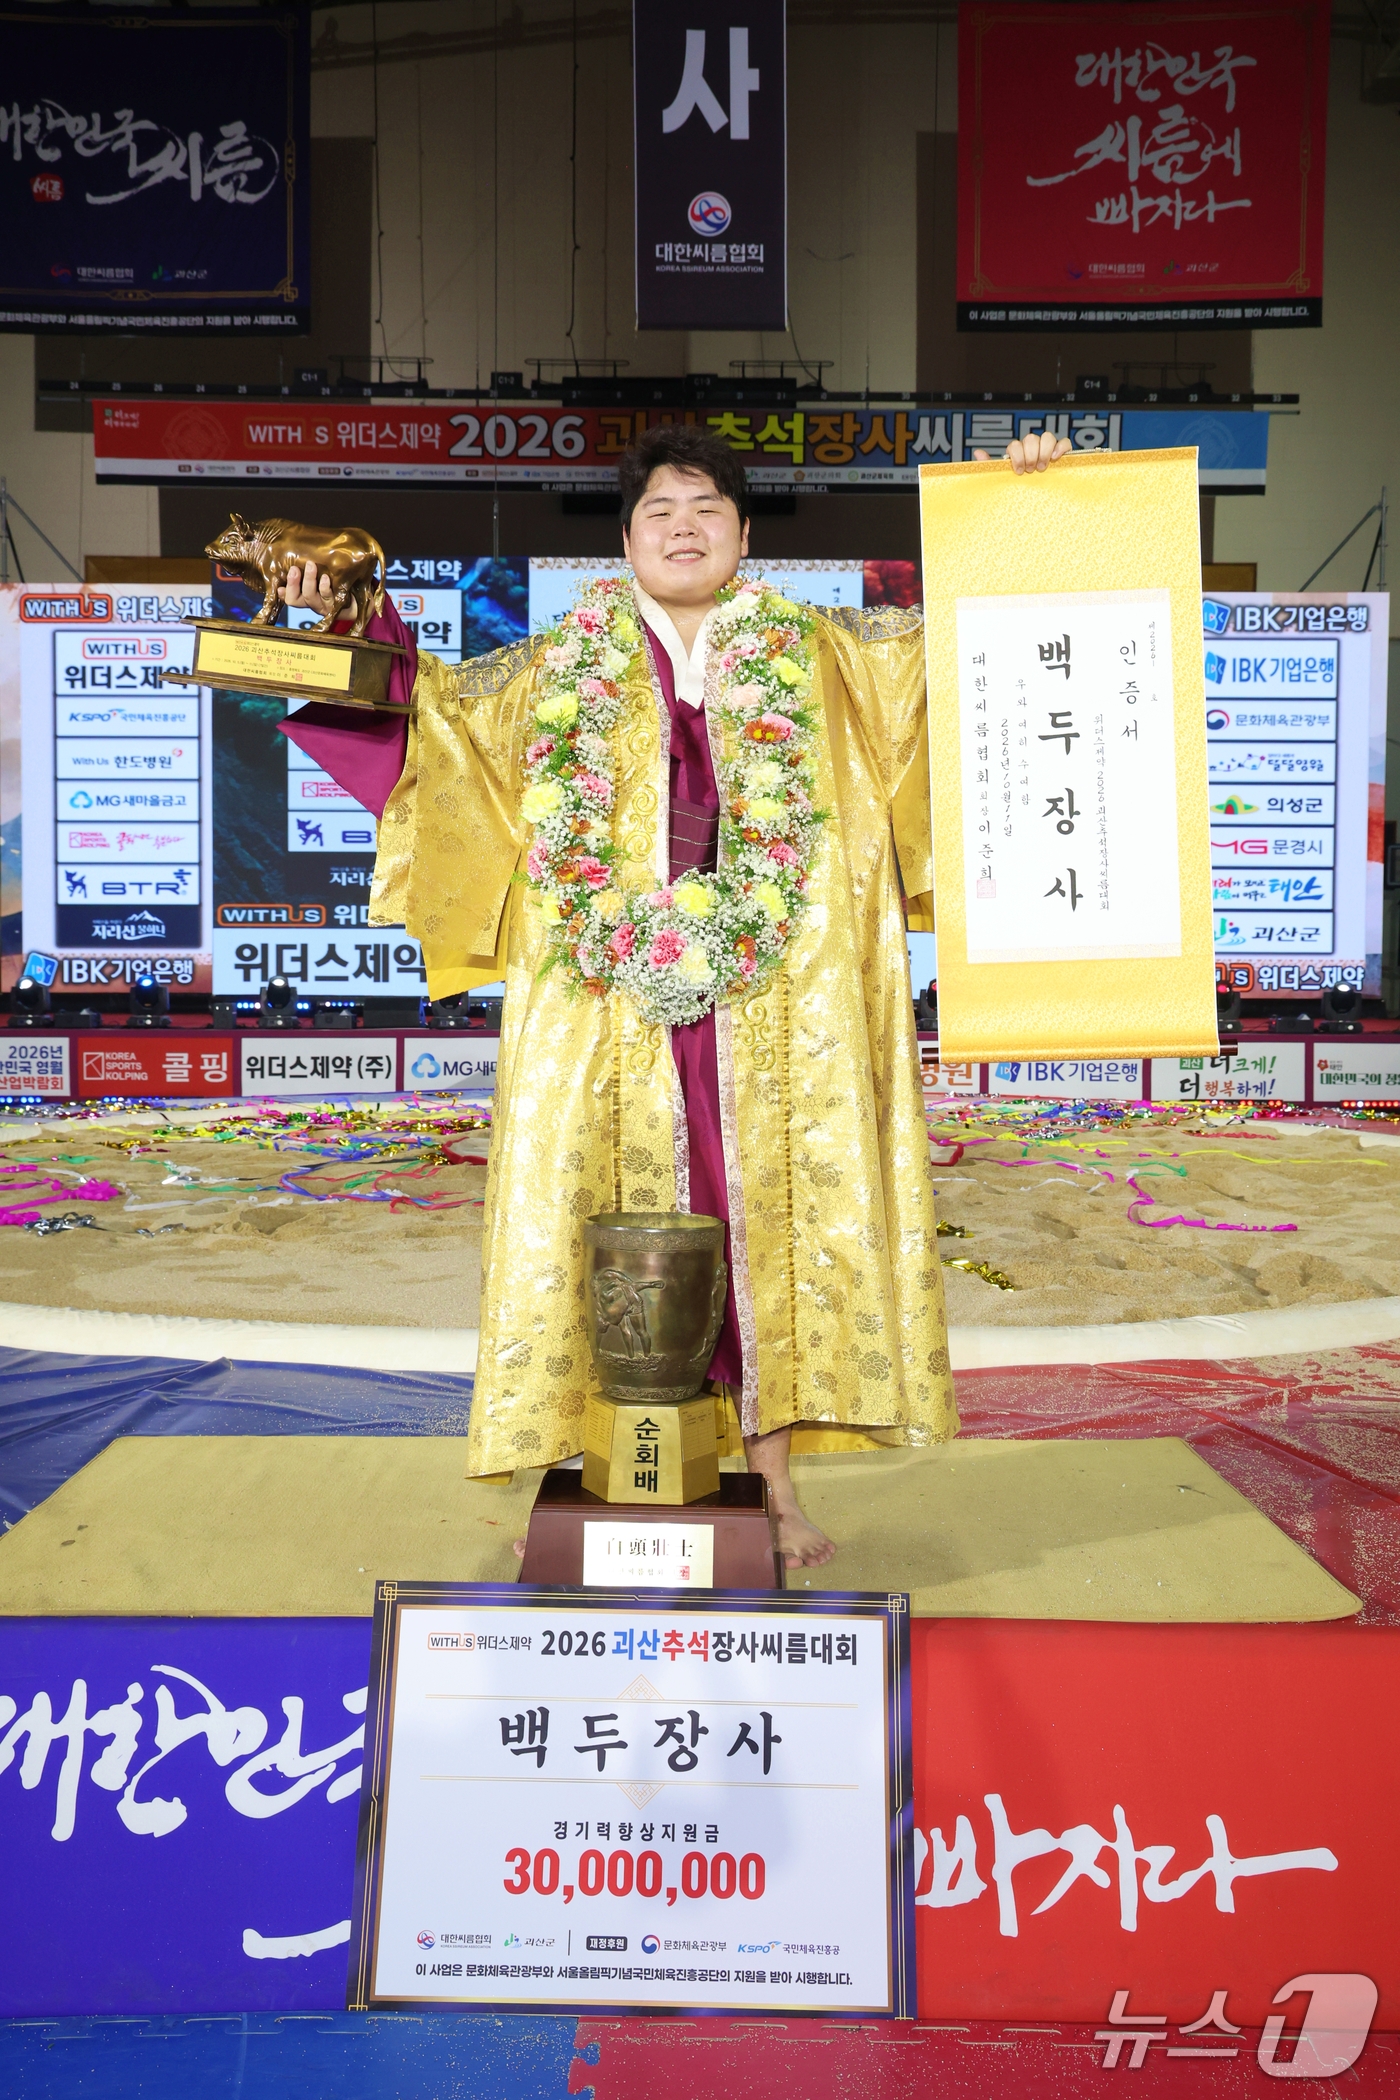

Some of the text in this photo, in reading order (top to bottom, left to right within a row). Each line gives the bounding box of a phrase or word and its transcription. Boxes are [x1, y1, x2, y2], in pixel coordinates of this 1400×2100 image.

[663, 27, 760, 140] 사
[655, 242, 765, 264] 대한씨름협회
[655, 265, 681, 273] KOREA
[716, 265, 765, 274] ASSOCIATION
[336, 421, 442, 451] 위더스제약
[448, 413, 587, 461] 2026
[1119, 640, 1141, 742] 인증서
[69, 712, 112, 723] KSPO
[972, 652, 991, 785] 대한씨름협회
[1235, 714, 1331, 727] 문화체육관광부
[114, 756, 173, 769] 한도병원
[1037, 633, 1085, 913] 백두장사
[1267, 798, 1324, 813] 의성군
[1271, 839, 1324, 856] 문경시
[102, 882, 181, 896] BTR
[1268, 876, 1326, 903] 태안
[223, 908, 322, 923] WITHUS
[1252, 926, 1322, 943] 괴산군
[1257, 965, 1366, 992] 위더스제약
[9, 1045, 64, 1060] 2026년
[105, 1052, 137, 1061] KOREA
[36, 1061, 64, 1075] 영월
[106, 1062, 143, 1071] SPORTS
[162, 1052, 229, 1083] 콜핑
[1232, 1055, 1278, 1075] 크게!
[106, 1072, 149, 1082] KOLPING
[1320, 1072, 1382, 1086] 대한민국의
[1179, 1072, 1201, 1100] 더
[634, 1417, 661, 1494] 순회배
[430, 1628, 859, 1667] WITHUS 위더스제약 2026 괴산추석장사씨름대회
[498, 1706, 784, 1776] 백두장사
[553, 1820, 720, 1843] 경기력향상지원금
[503, 1847, 766, 1907] 30,000,000
[440, 1933, 492, 1944] 대한씨름협회
[524, 1937, 556, 1948] 괴산군
[589, 1937, 625, 1950] 재정후원
[663, 1940, 728, 1952] 문화체육관광부
[737, 1943, 841, 1956] KSPO 국민체육진흥공
[415, 1963, 853, 1986] 이 사업은 문화체육관광부와 서울올림픽기념국민체육진흥공단의 지원을 받아 시행합니다.
